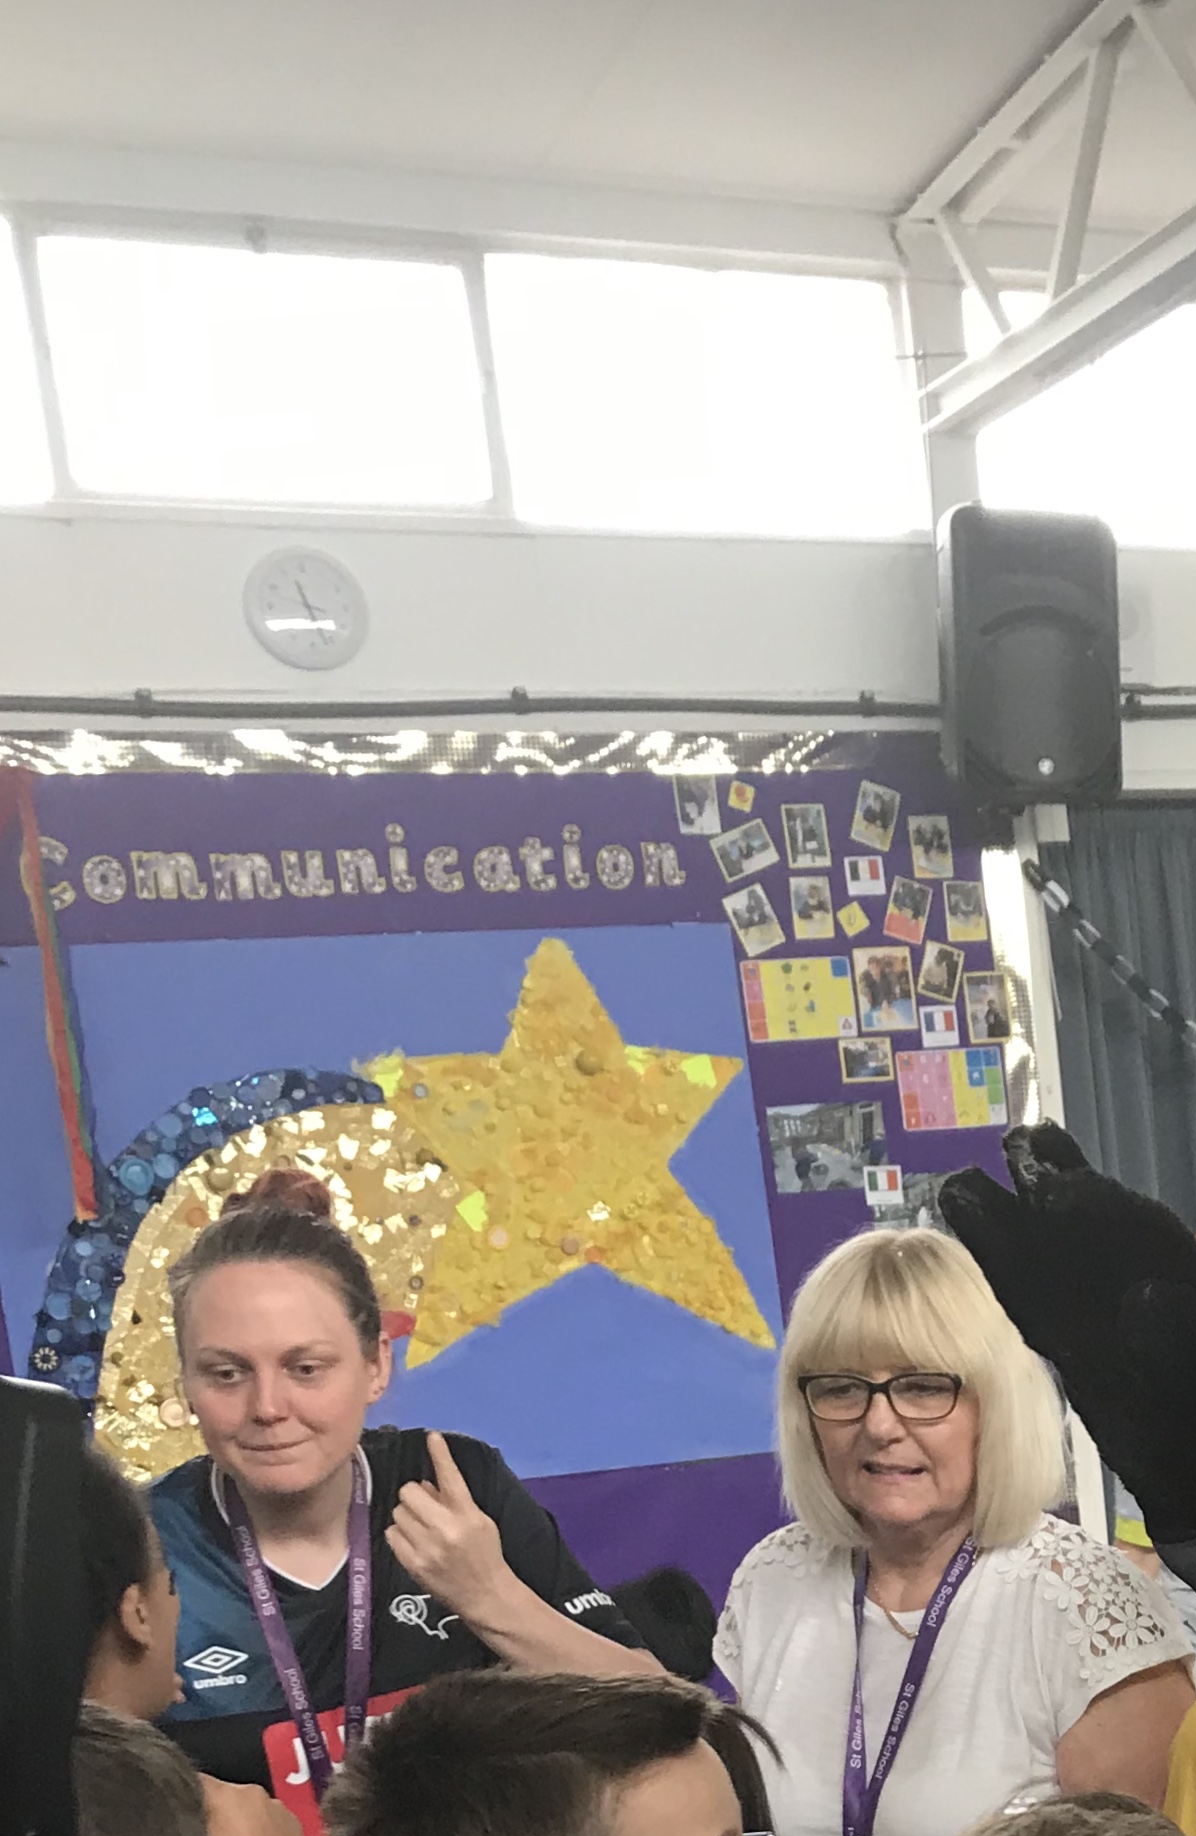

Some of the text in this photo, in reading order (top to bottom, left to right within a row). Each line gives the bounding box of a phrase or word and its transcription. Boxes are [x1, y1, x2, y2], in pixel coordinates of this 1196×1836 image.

[20, 822, 687, 911] Communication
[946, 1553, 969, 1583] Giles
[926, 1585, 953, 1627] School
[353, 1609, 366, 1650] School
[193, 1673, 247, 1690] umbro
[891, 1700, 909, 1732] Giles
[850, 1753, 862, 1768] St
[875, 1735, 897, 1779] School
